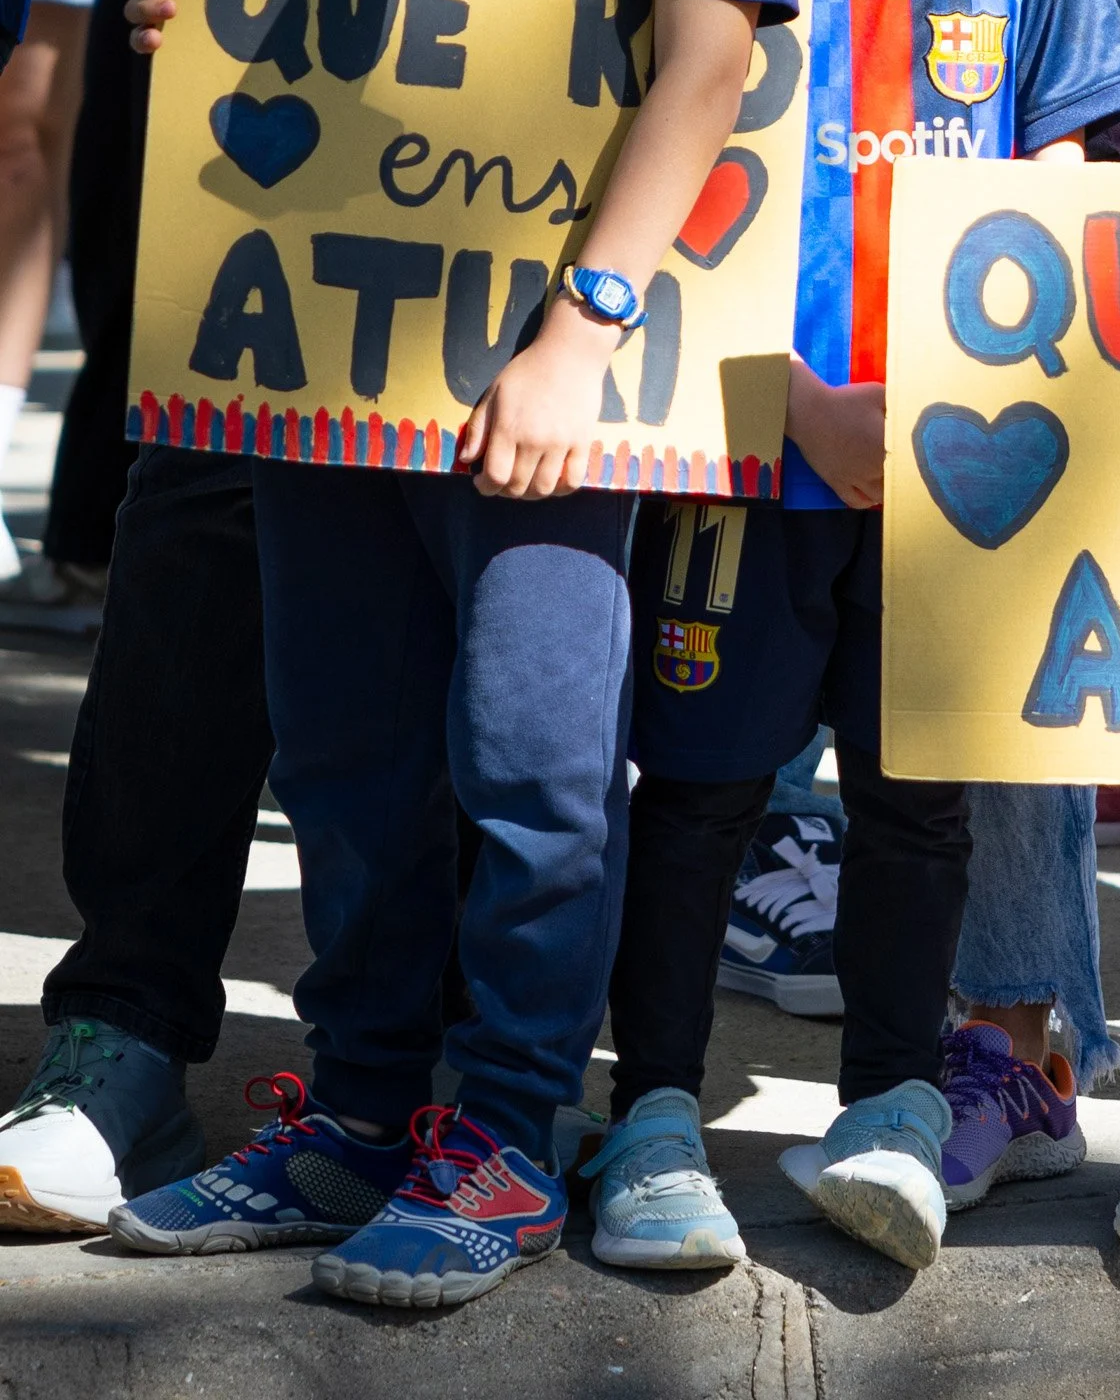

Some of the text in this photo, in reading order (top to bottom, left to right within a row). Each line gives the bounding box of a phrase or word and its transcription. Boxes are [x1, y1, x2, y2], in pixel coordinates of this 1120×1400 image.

[955, 51, 986, 62] FCB
[380, 133, 592, 225] ens
[663, 501, 748, 614] 11
